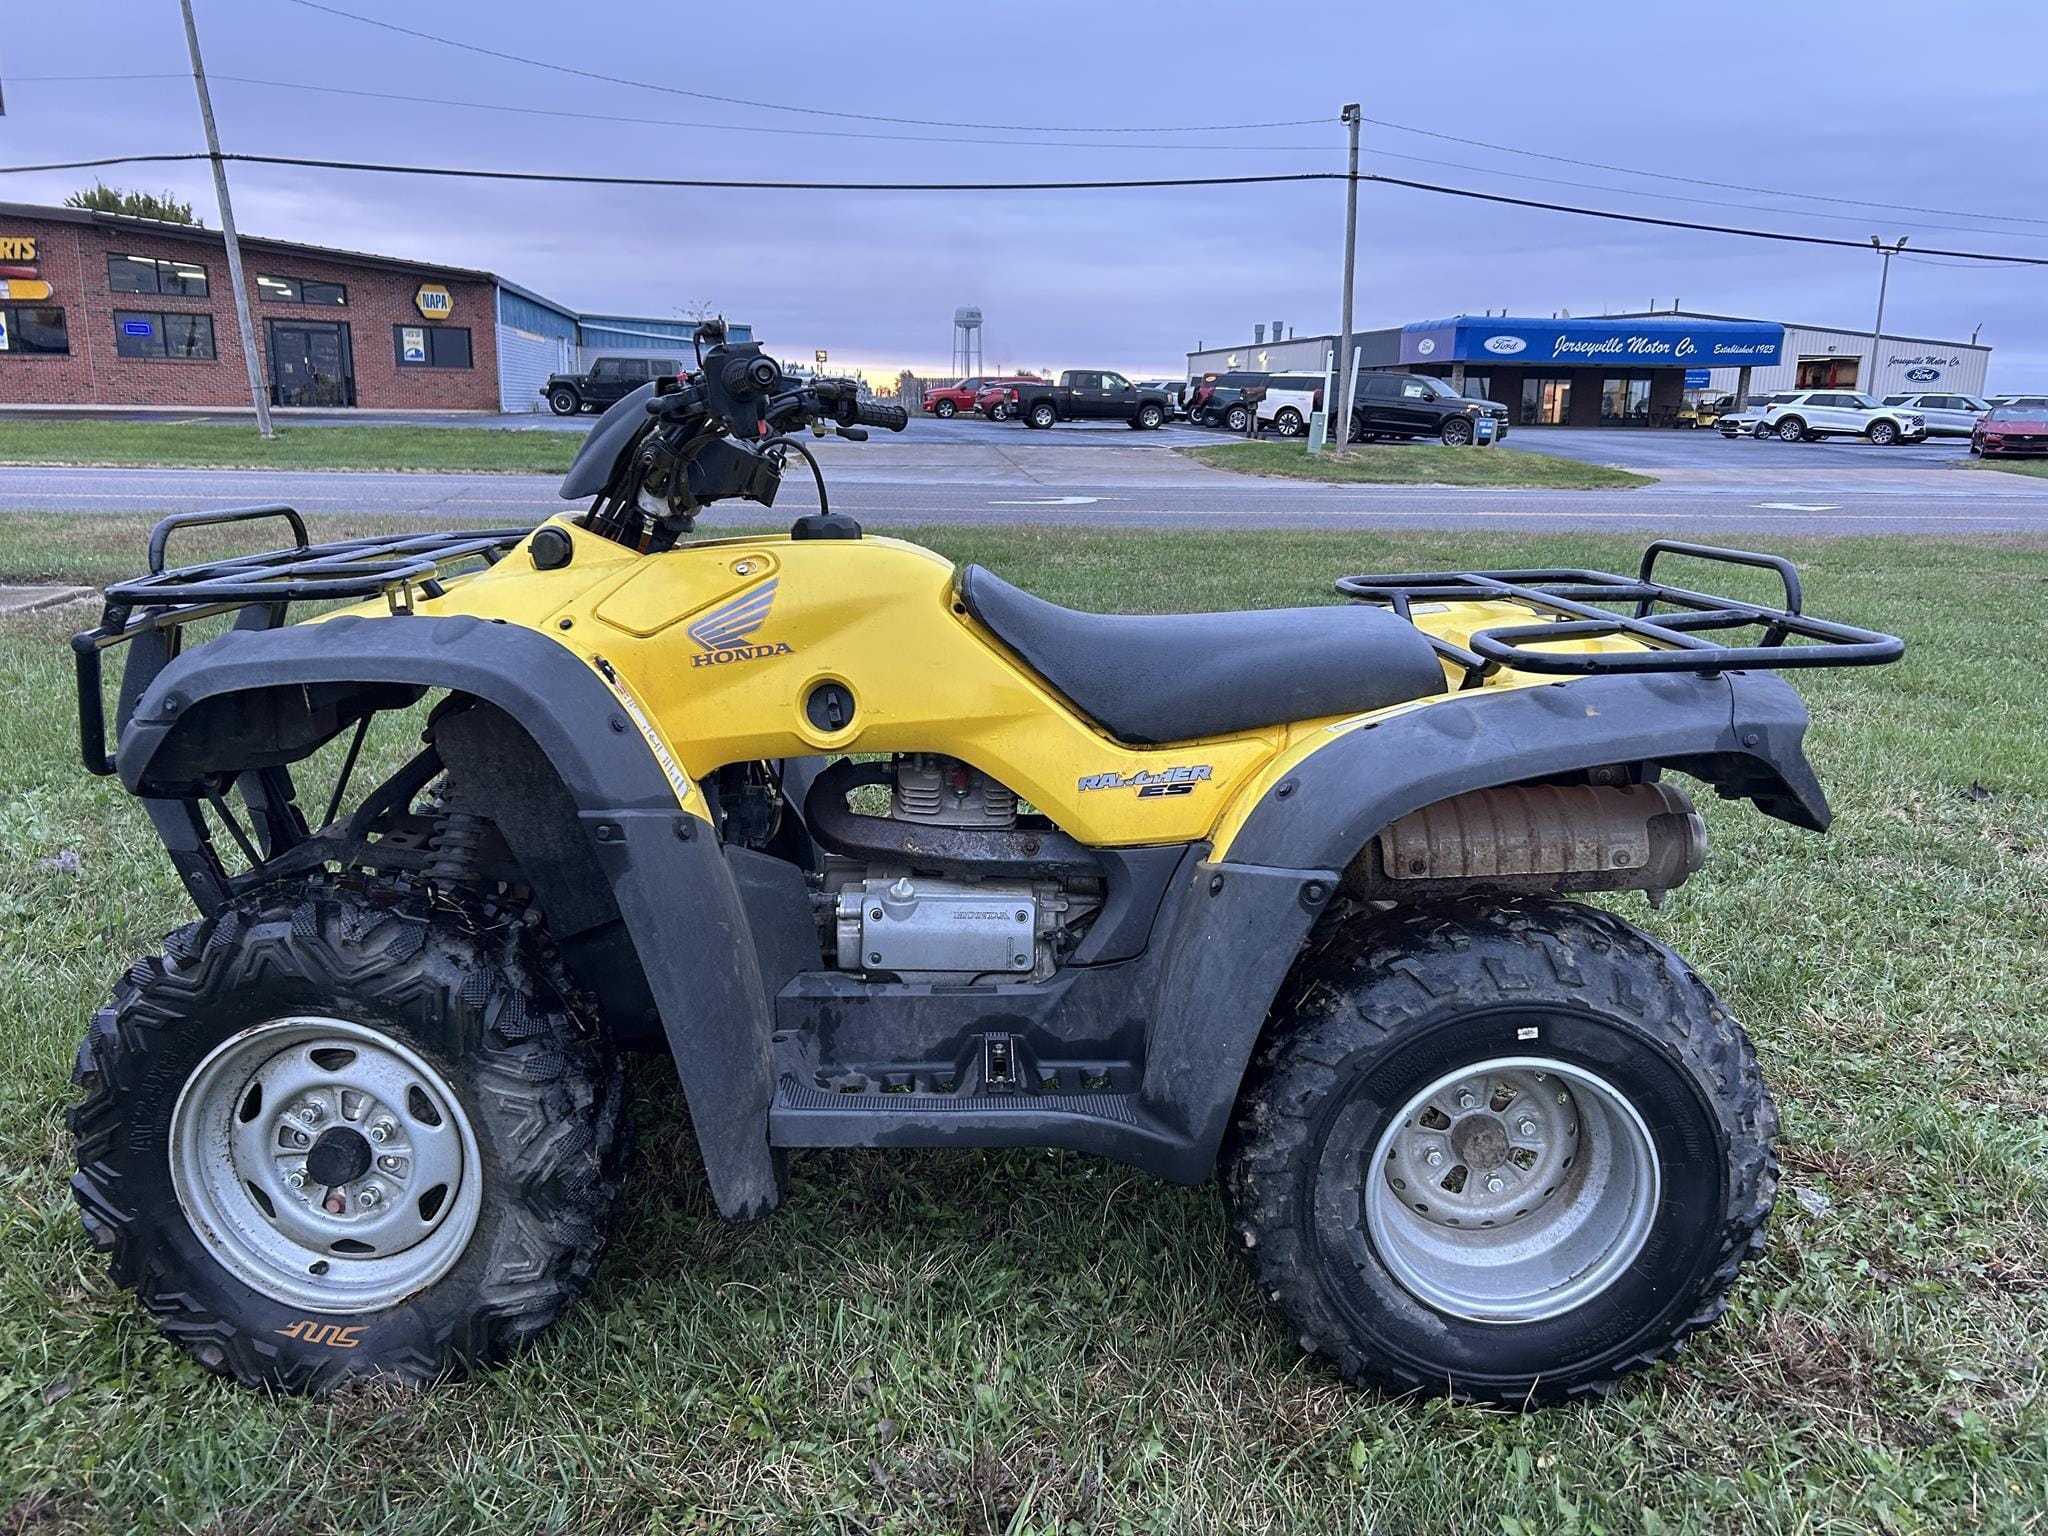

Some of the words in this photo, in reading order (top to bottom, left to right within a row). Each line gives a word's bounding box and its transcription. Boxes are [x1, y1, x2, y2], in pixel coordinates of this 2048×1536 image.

[422, 293, 448, 309] NAPA
[1552, 335, 1623, 357] Jerseyville
[1627, 336, 1670, 354] Motor
[1675, 337, 1698, 357] Co.
[1713, 343, 1755, 354] Established
[1755, 344, 1776, 354] 1923
[1887, 355, 1924, 367] Jerseyville
[1925, 356, 1947, 366] Motor
[690, 642, 795, 667] HONDA
[1137, 782, 1196, 798] ES
[953, 911, 1010, 920] HONDA
